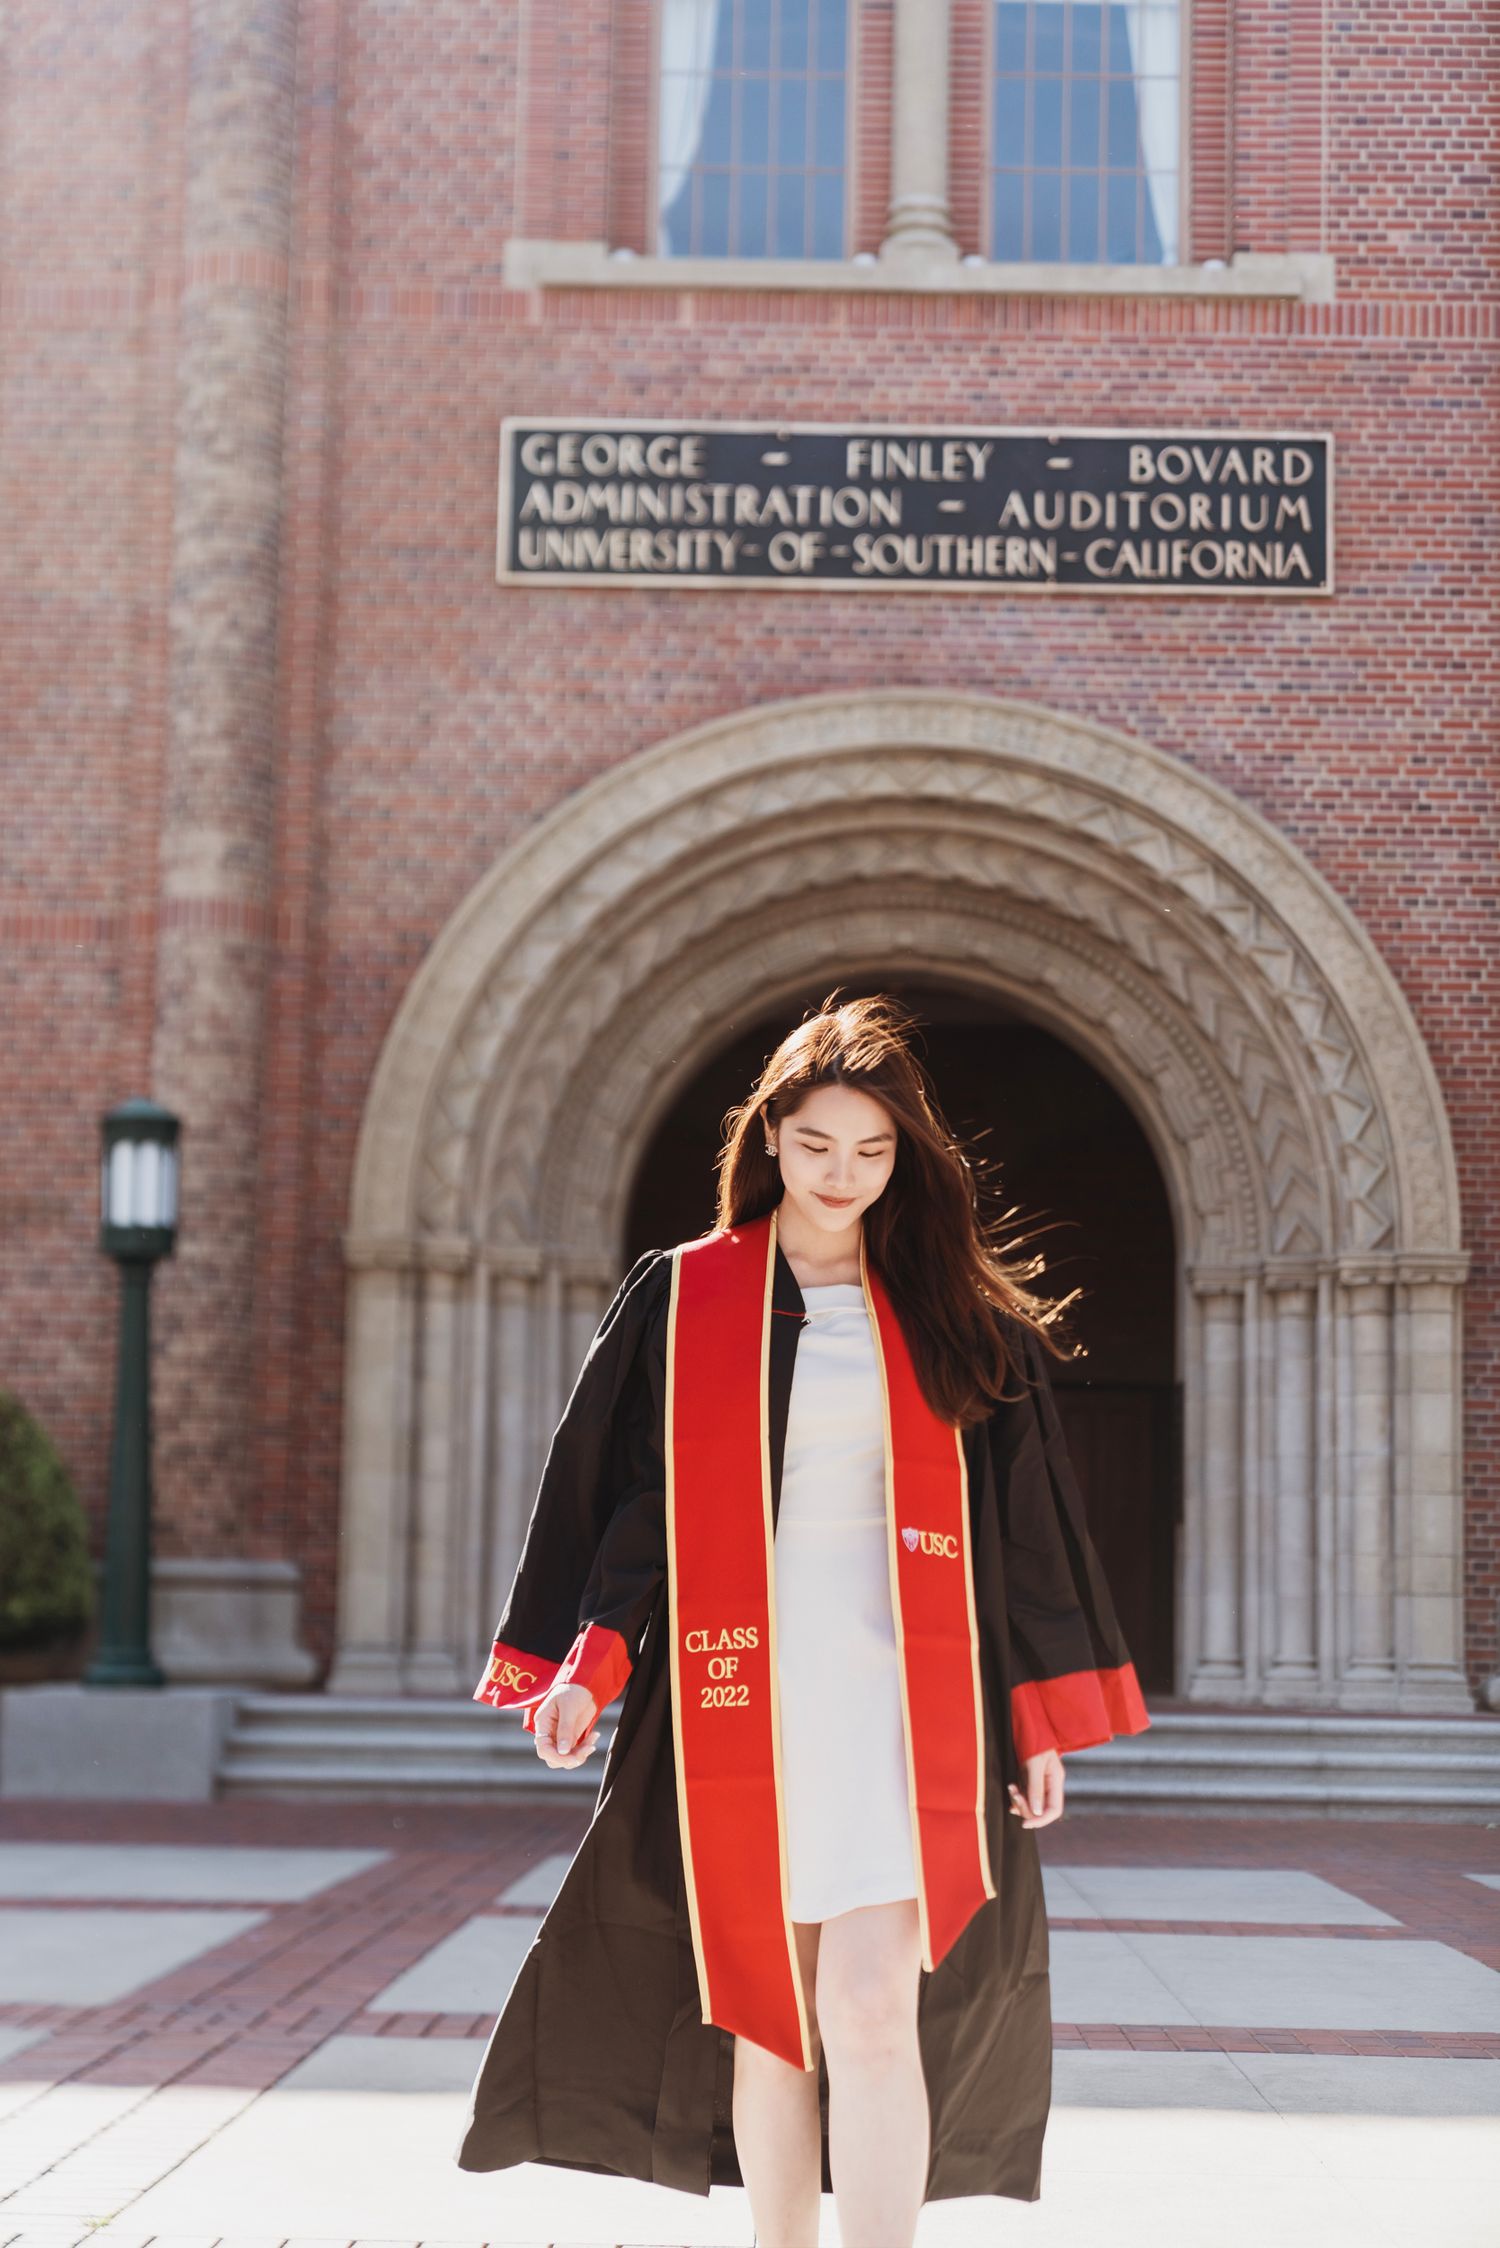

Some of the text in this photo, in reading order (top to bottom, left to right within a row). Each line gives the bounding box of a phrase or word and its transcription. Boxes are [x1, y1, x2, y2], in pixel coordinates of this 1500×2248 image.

[520, 433, 706, 477] GEORGE
[846, 439, 993, 481] FINLEY
[1129, 445, 1313, 485] BOVARD
[519, 481, 901, 527] ADMINISTRATION
[998, 490, 1311, 532] AUDITORIUM
[919, 1530, 959, 1559] USC
[685, 1626, 759, 1653] CLASS
[489, 1657, 538, 1693] USC
[707, 1656, 739, 1680] OF
[700, 1684, 750, 1709] 2022
